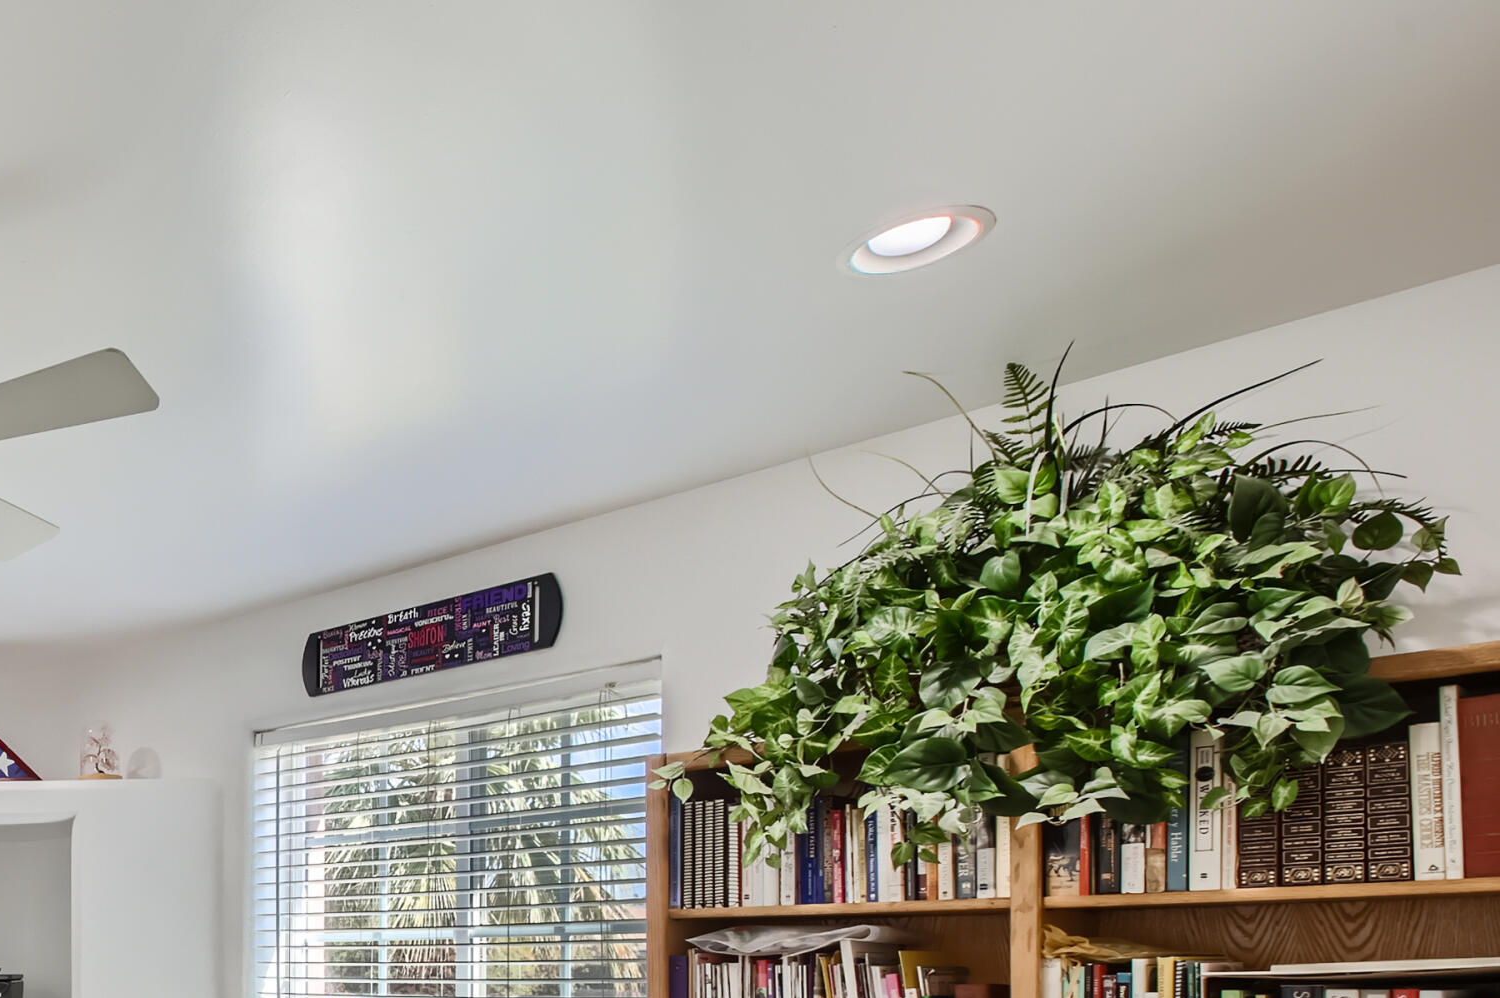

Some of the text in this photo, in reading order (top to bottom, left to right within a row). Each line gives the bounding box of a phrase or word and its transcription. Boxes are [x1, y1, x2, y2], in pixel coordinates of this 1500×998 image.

[461, 584, 528, 612] FRIEND
[485, 601, 519, 614] BEAUTIFUL
[472, 620, 491, 628] AUNT
[1417, 752, 1430, 771] THE
[1432, 752, 1444, 849] ALFRED HITCHCOCK PRESENTS
[1170, 832, 1183, 863] Hablar
[1419, 818, 1433, 849] CHOICE
